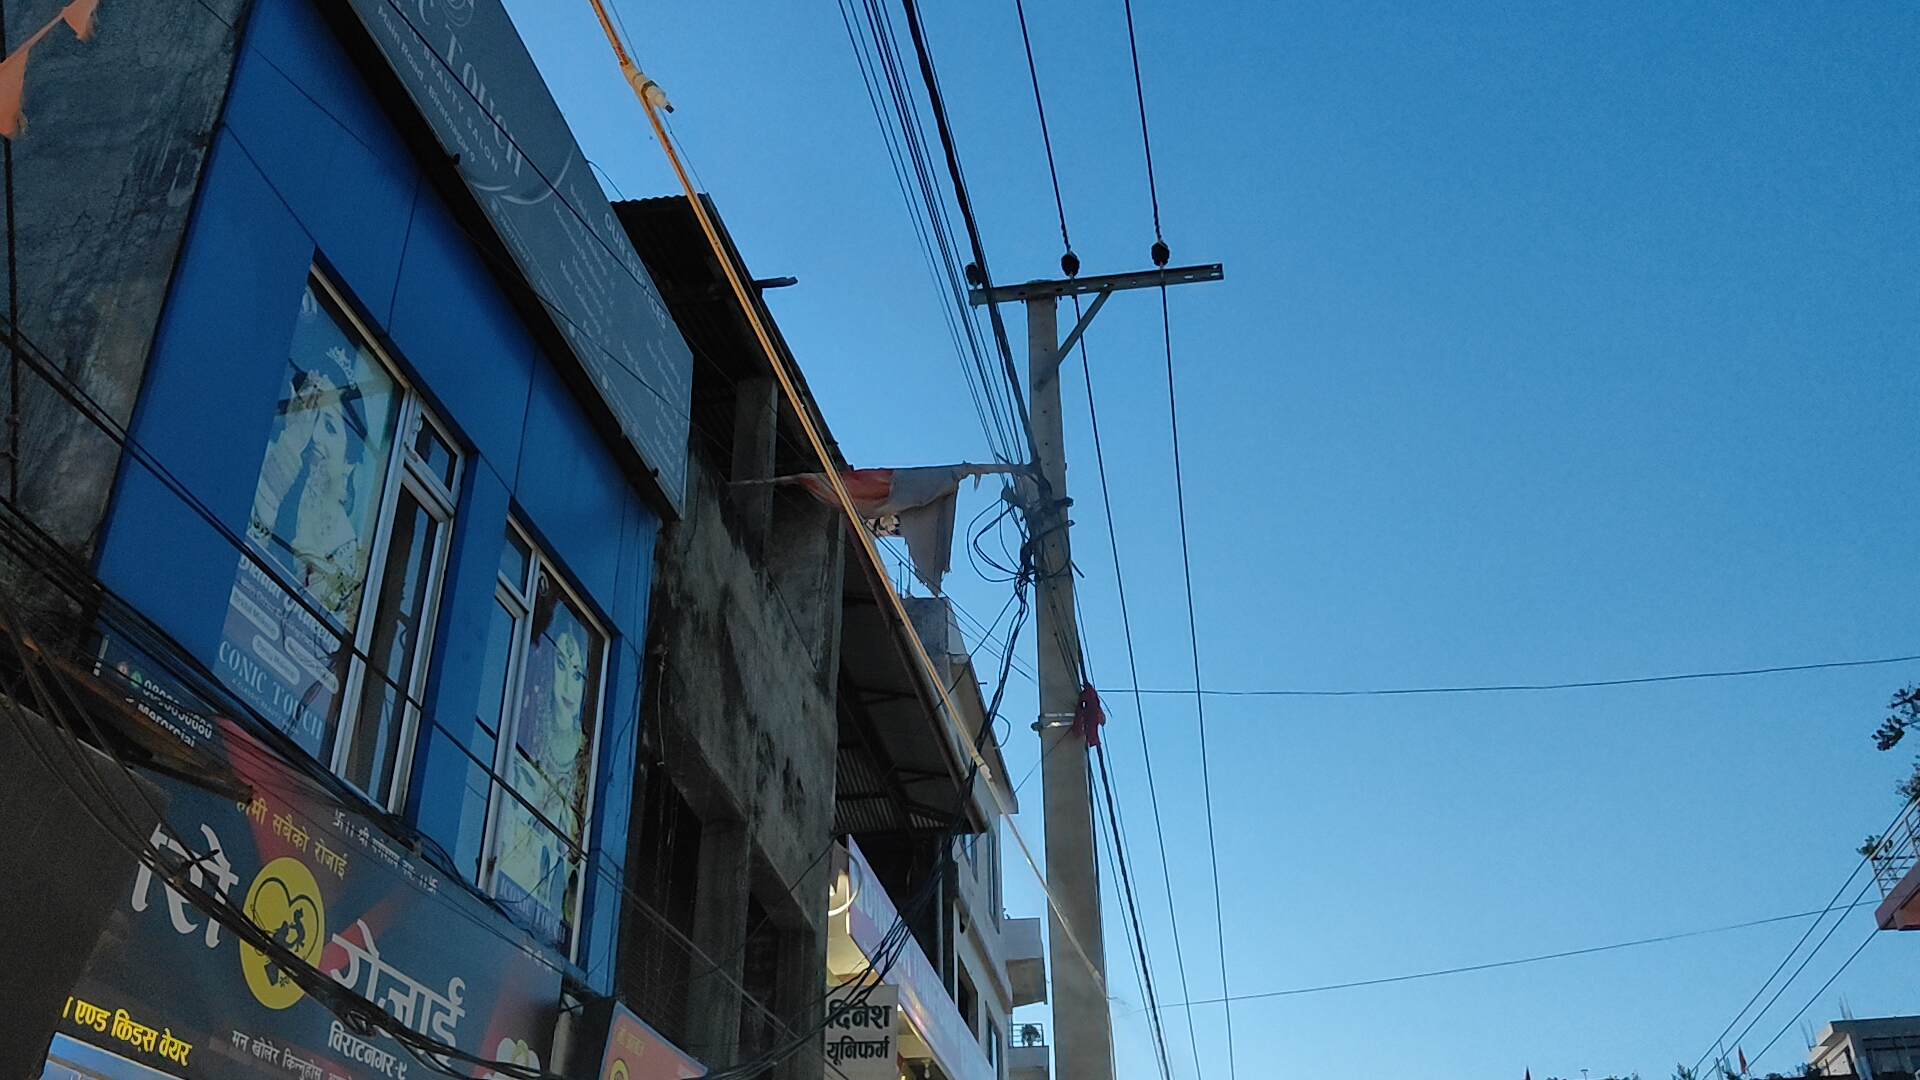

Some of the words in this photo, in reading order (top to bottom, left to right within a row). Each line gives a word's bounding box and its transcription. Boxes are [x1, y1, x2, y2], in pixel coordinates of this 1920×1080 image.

[378, 5, 400, 45] Main
[401, 41, 424, 82] Road
[423, 45, 464, 114] BEAUTY
[467, 116, 499, 172] SALON
[604, 212, 626, 257] OUR
[627, 258, 666, 330] SERVICES
[272, 681, 323, 740] TOUCH
[272, 813, 310, 853] सबैको
[315, 841, 349, 881] रोजाई
[74, 999, 112, 1034] एण्ड
[828, 999, 893, 1030] दिनेश
[232, 1029, 248, 1053] मन
[251, 1036, 281, 1067] खोलेर
[826, 1036, 890, 1066] यूनिफर्म
